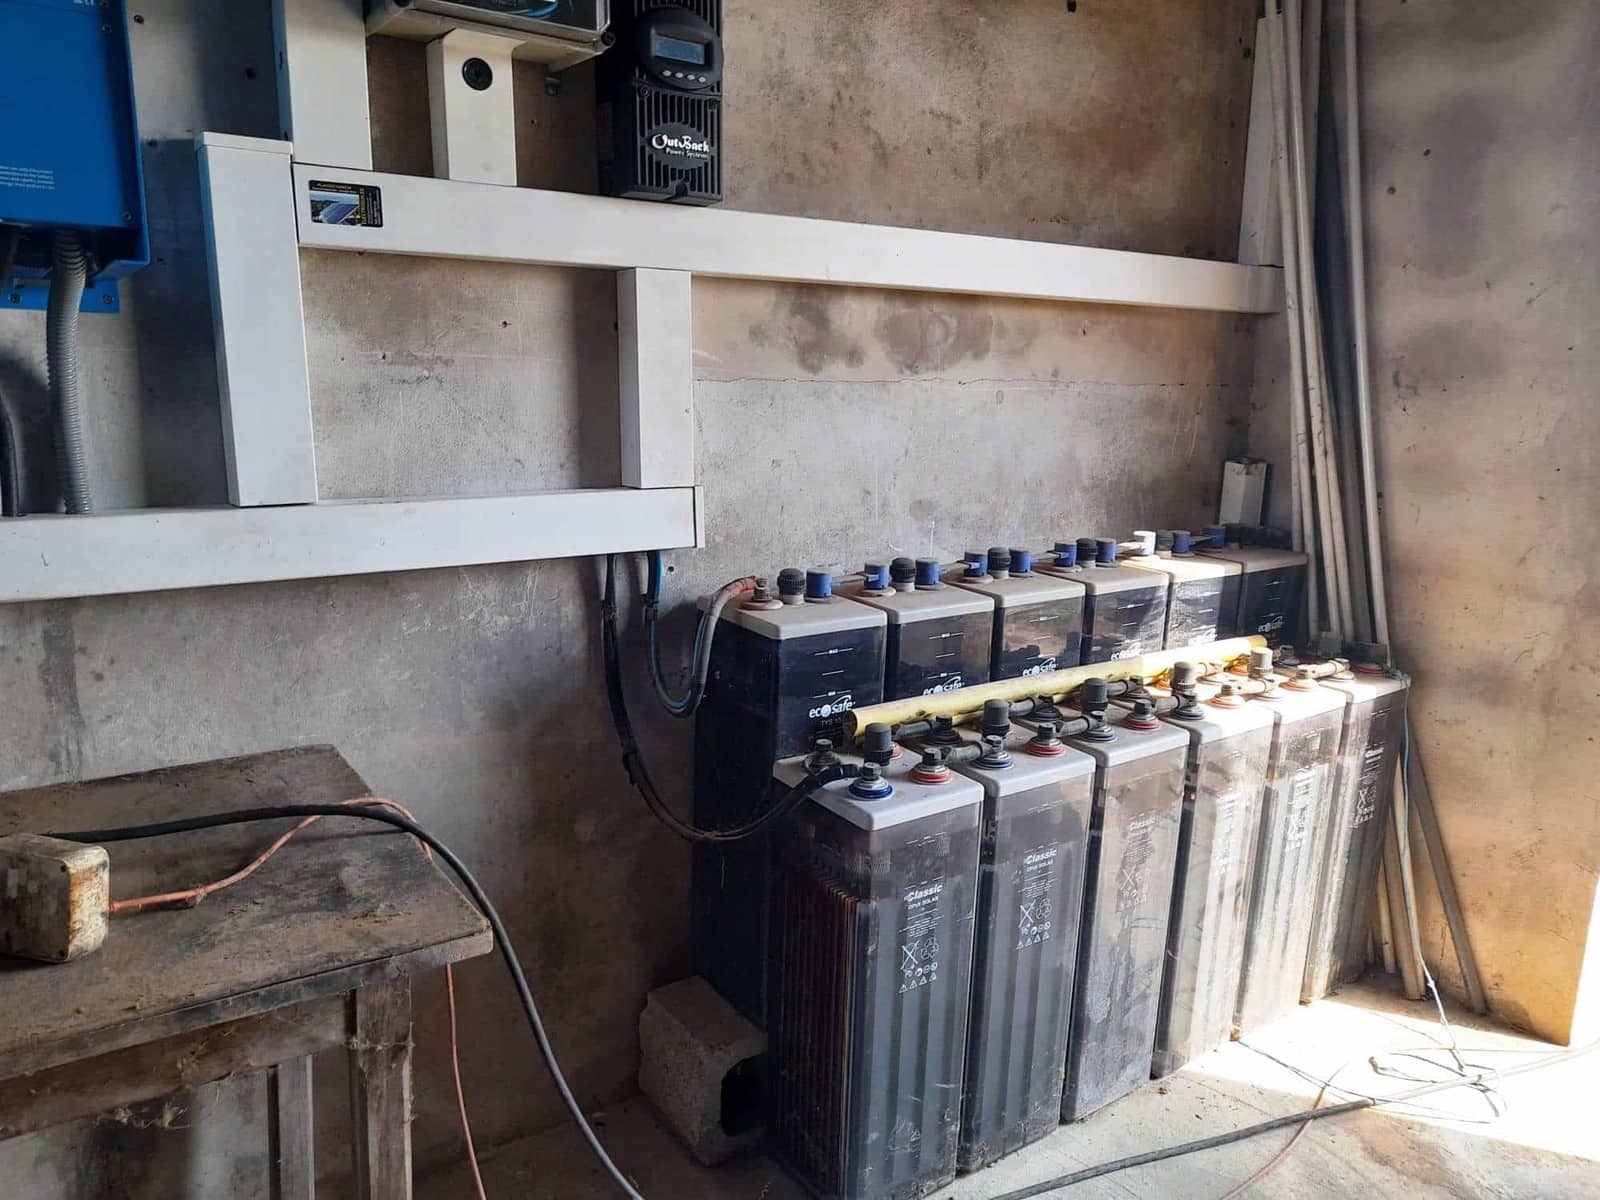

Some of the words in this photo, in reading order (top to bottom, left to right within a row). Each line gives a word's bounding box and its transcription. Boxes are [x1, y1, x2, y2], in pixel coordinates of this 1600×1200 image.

[652, 134, 710, 152] OutBack
[808, 695, 853, 719] ecosafe
[1026, 848, 1057, 865] Classic
[906, 884, 943, 902] Classic
